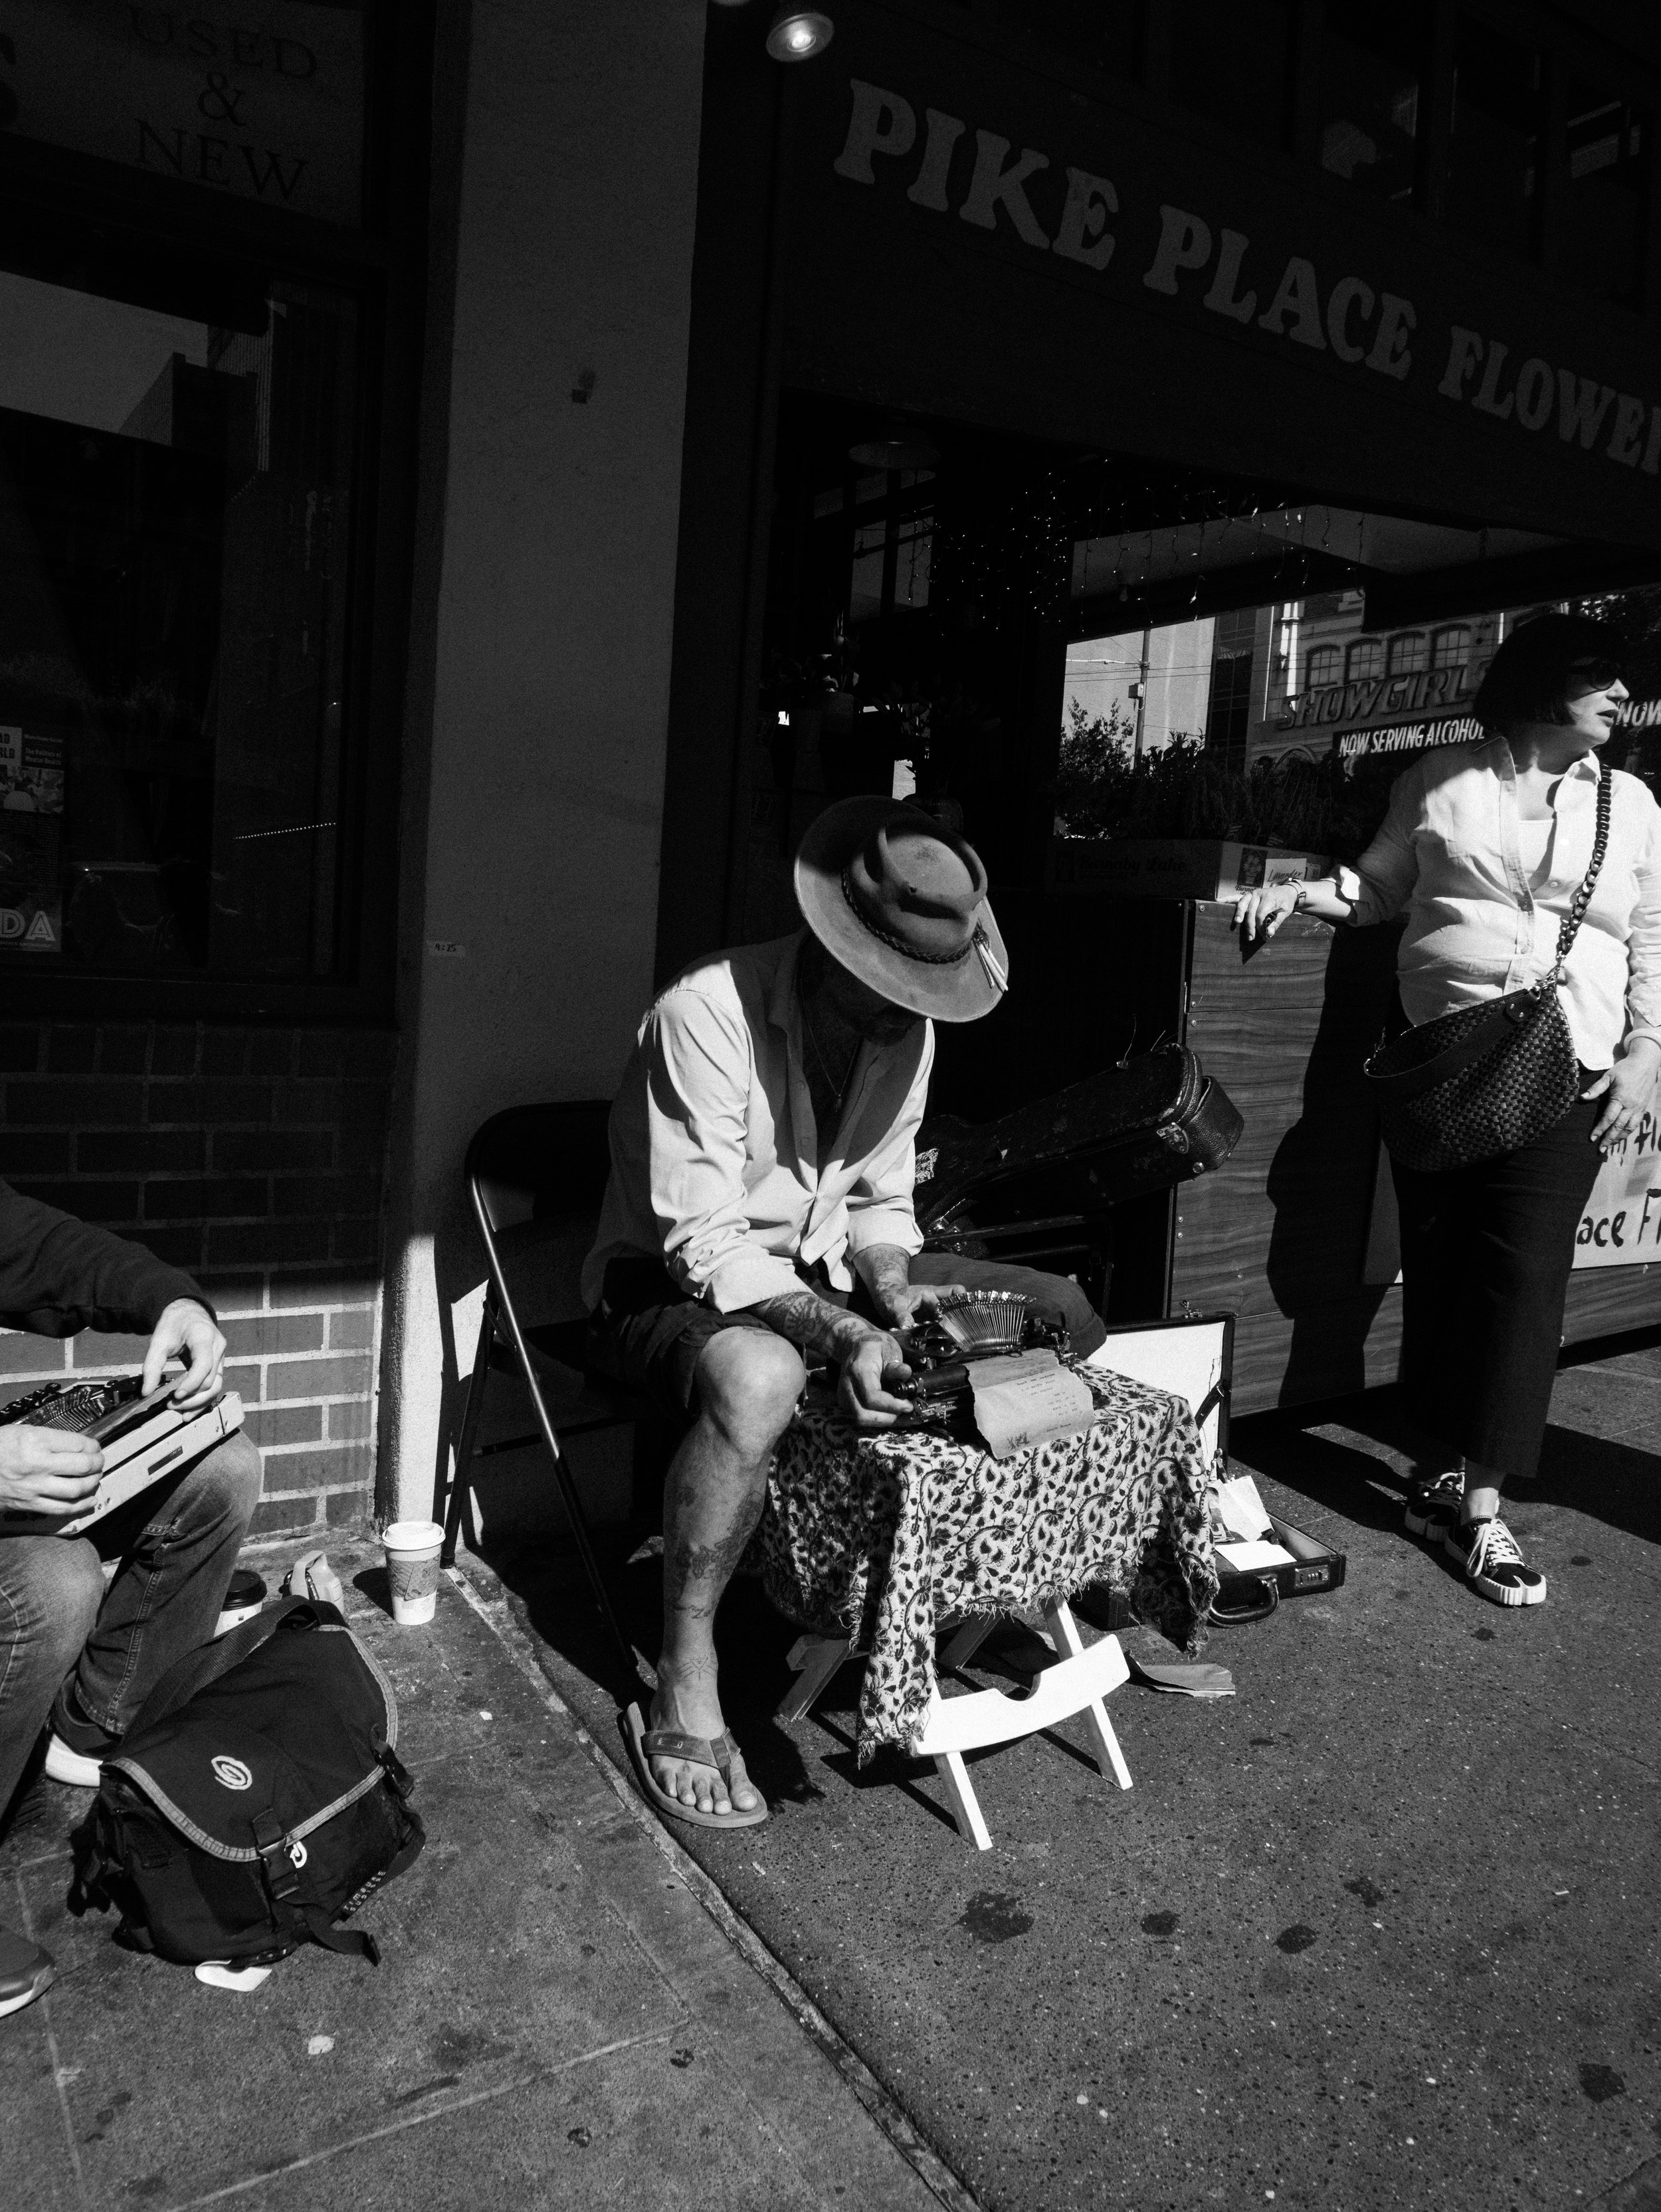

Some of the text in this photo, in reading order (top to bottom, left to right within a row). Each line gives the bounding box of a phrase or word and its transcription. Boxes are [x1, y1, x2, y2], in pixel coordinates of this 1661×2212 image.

[128, 4, 318, 80] USED
[198, 71, 246, 126] &
[135, 118, 309, 200] NEW
[834, 77, 1120, 271] PIKE
[1142, 203, 1417, 381] PLACE
[1338, 718, 1485, 758] NOW SERVING ALCOHOL
[1265, 868, 1303, 882] Lavender
